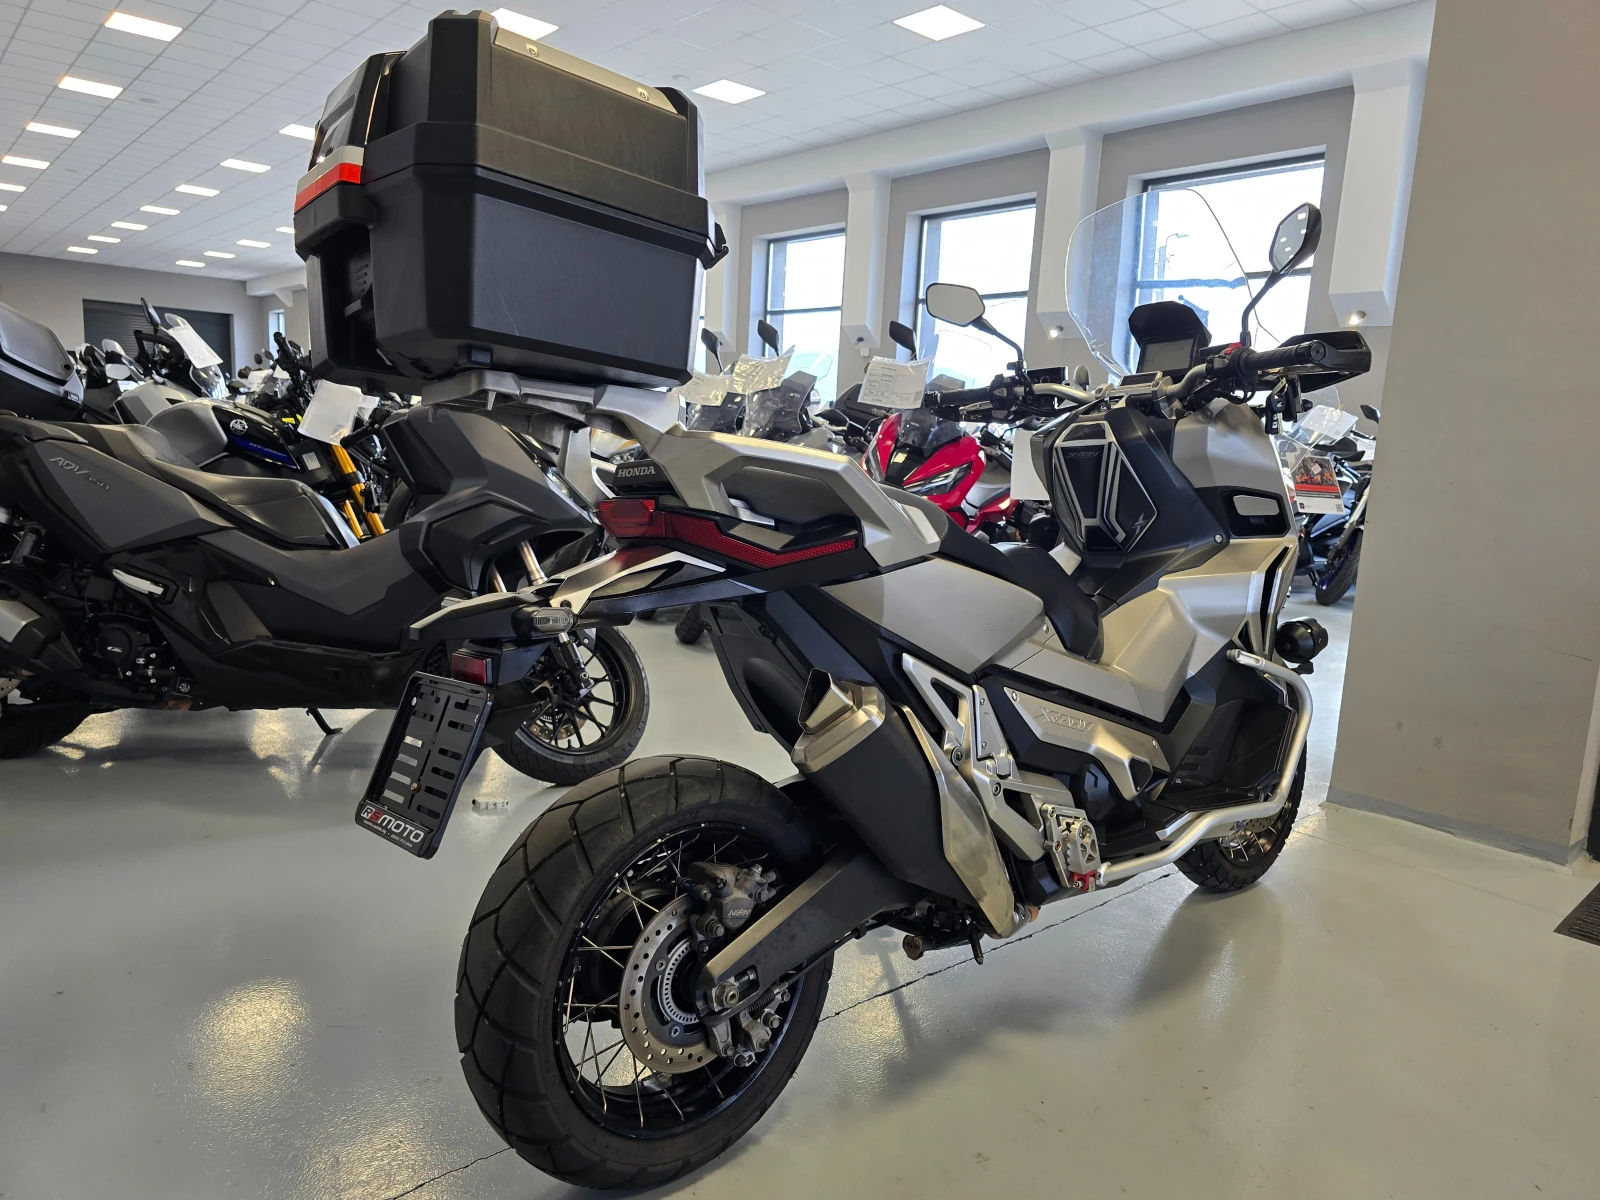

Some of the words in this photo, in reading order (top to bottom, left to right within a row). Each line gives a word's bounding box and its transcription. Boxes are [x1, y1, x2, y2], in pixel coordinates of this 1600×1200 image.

[48, 456, 91, 475] ADV
[616, 465, 656, 478] HONDA
[360, 805, 425, 843] RSMOTO
